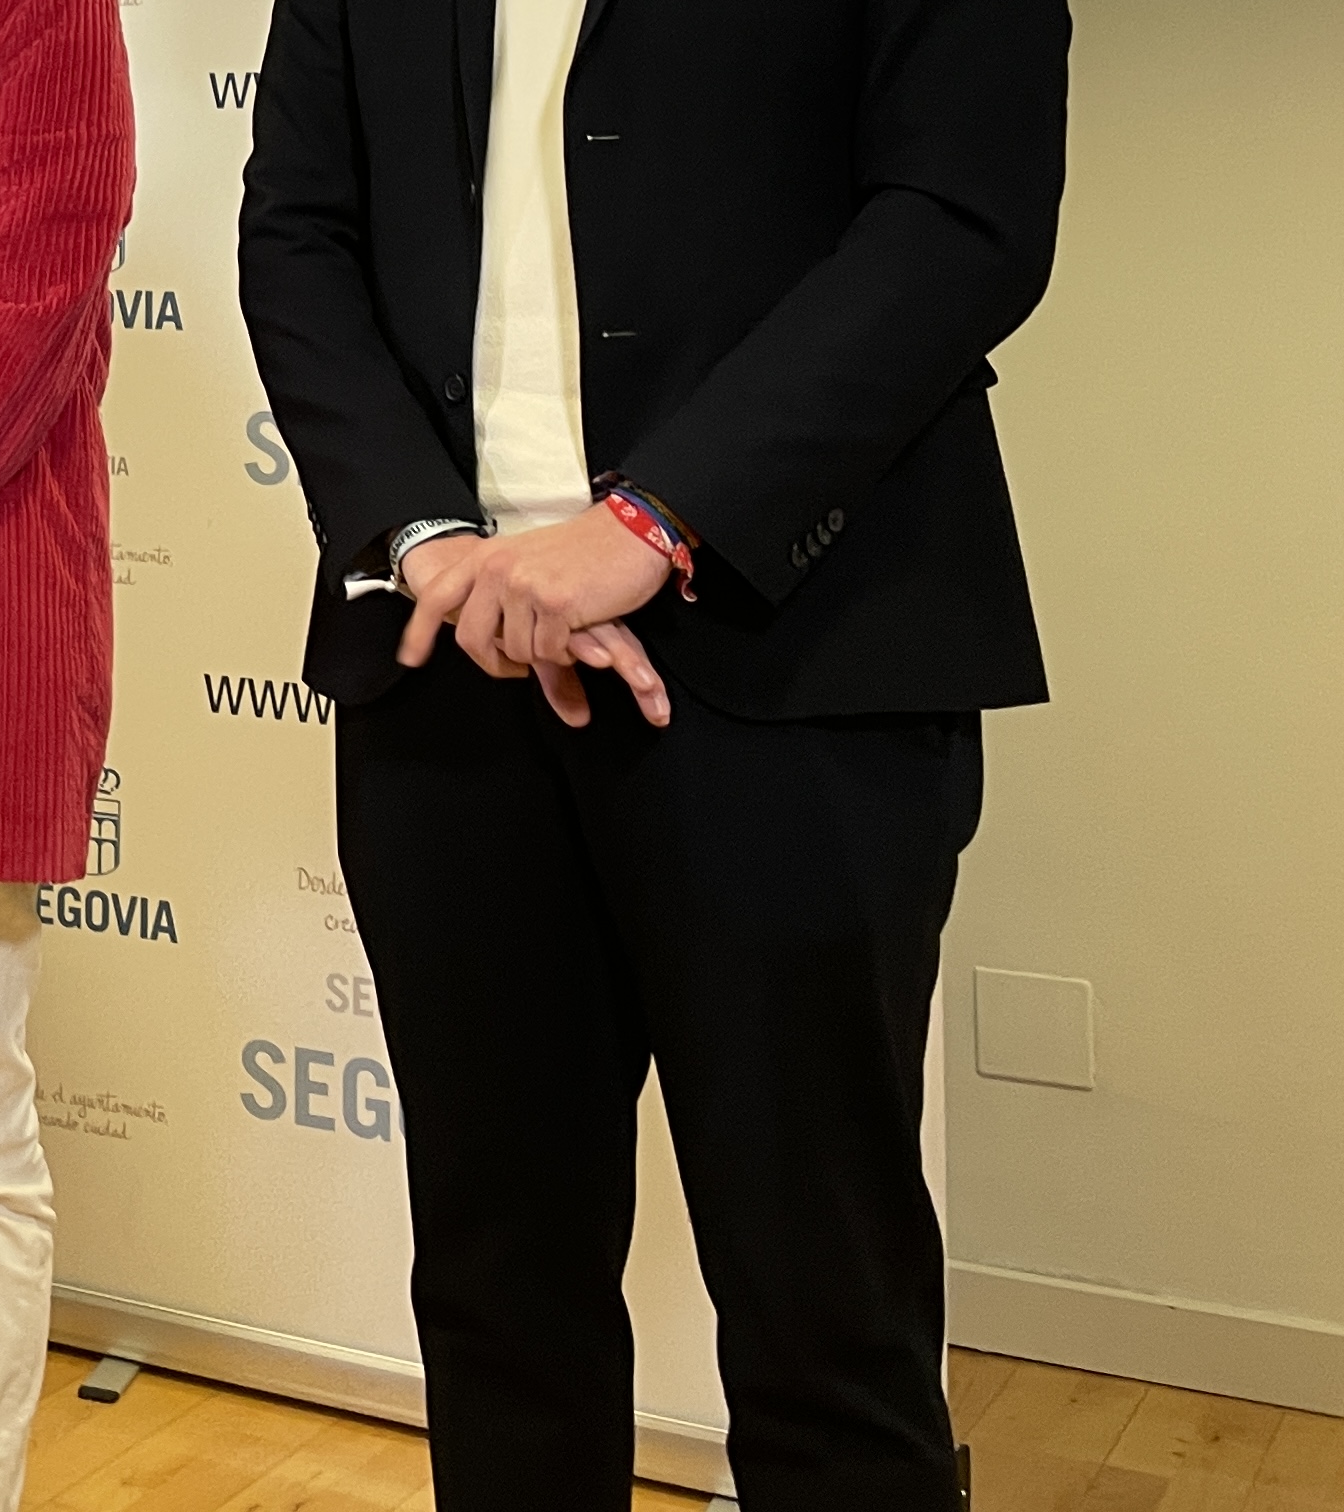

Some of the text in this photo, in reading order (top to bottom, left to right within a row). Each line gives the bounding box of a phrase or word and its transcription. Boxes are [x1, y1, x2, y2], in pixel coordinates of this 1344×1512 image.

[111, 289, 184, 330] VIA
[36, 884, 179, 945] EGOVIA
[240, 1039, 405, 1143] SEG
